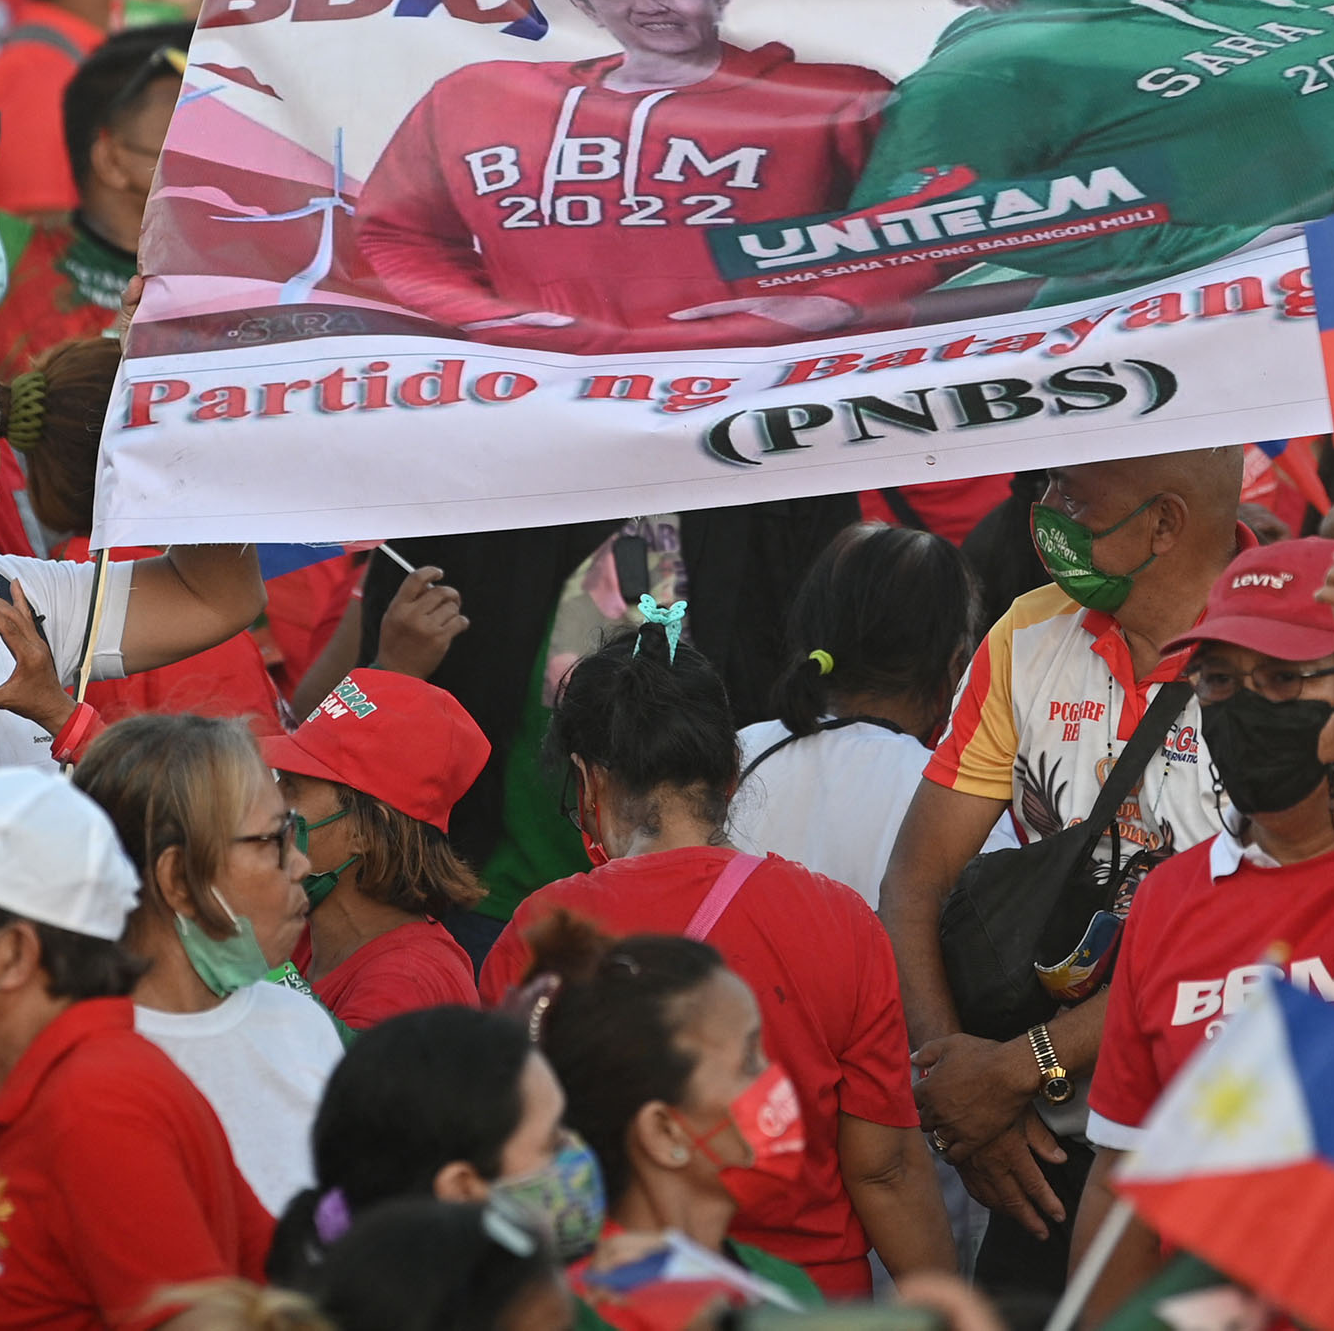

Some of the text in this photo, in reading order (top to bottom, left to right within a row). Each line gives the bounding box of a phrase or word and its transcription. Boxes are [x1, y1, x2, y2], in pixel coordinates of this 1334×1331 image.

[1137, 22, 1324, 98] SARA
[465, 135, 768, 198] BBM
[499, 192, 737, 229] 2022
[738, 166, 1146, 270] UNITEAM
[884, 243, 974, 267] TAYONG
[977, 222, 1096, 252] BABANGON
[122, 357, 538, 432] Partido
[583, 369, 741, 414] ng
[707, 357, 1179, 467] (PNBS)
